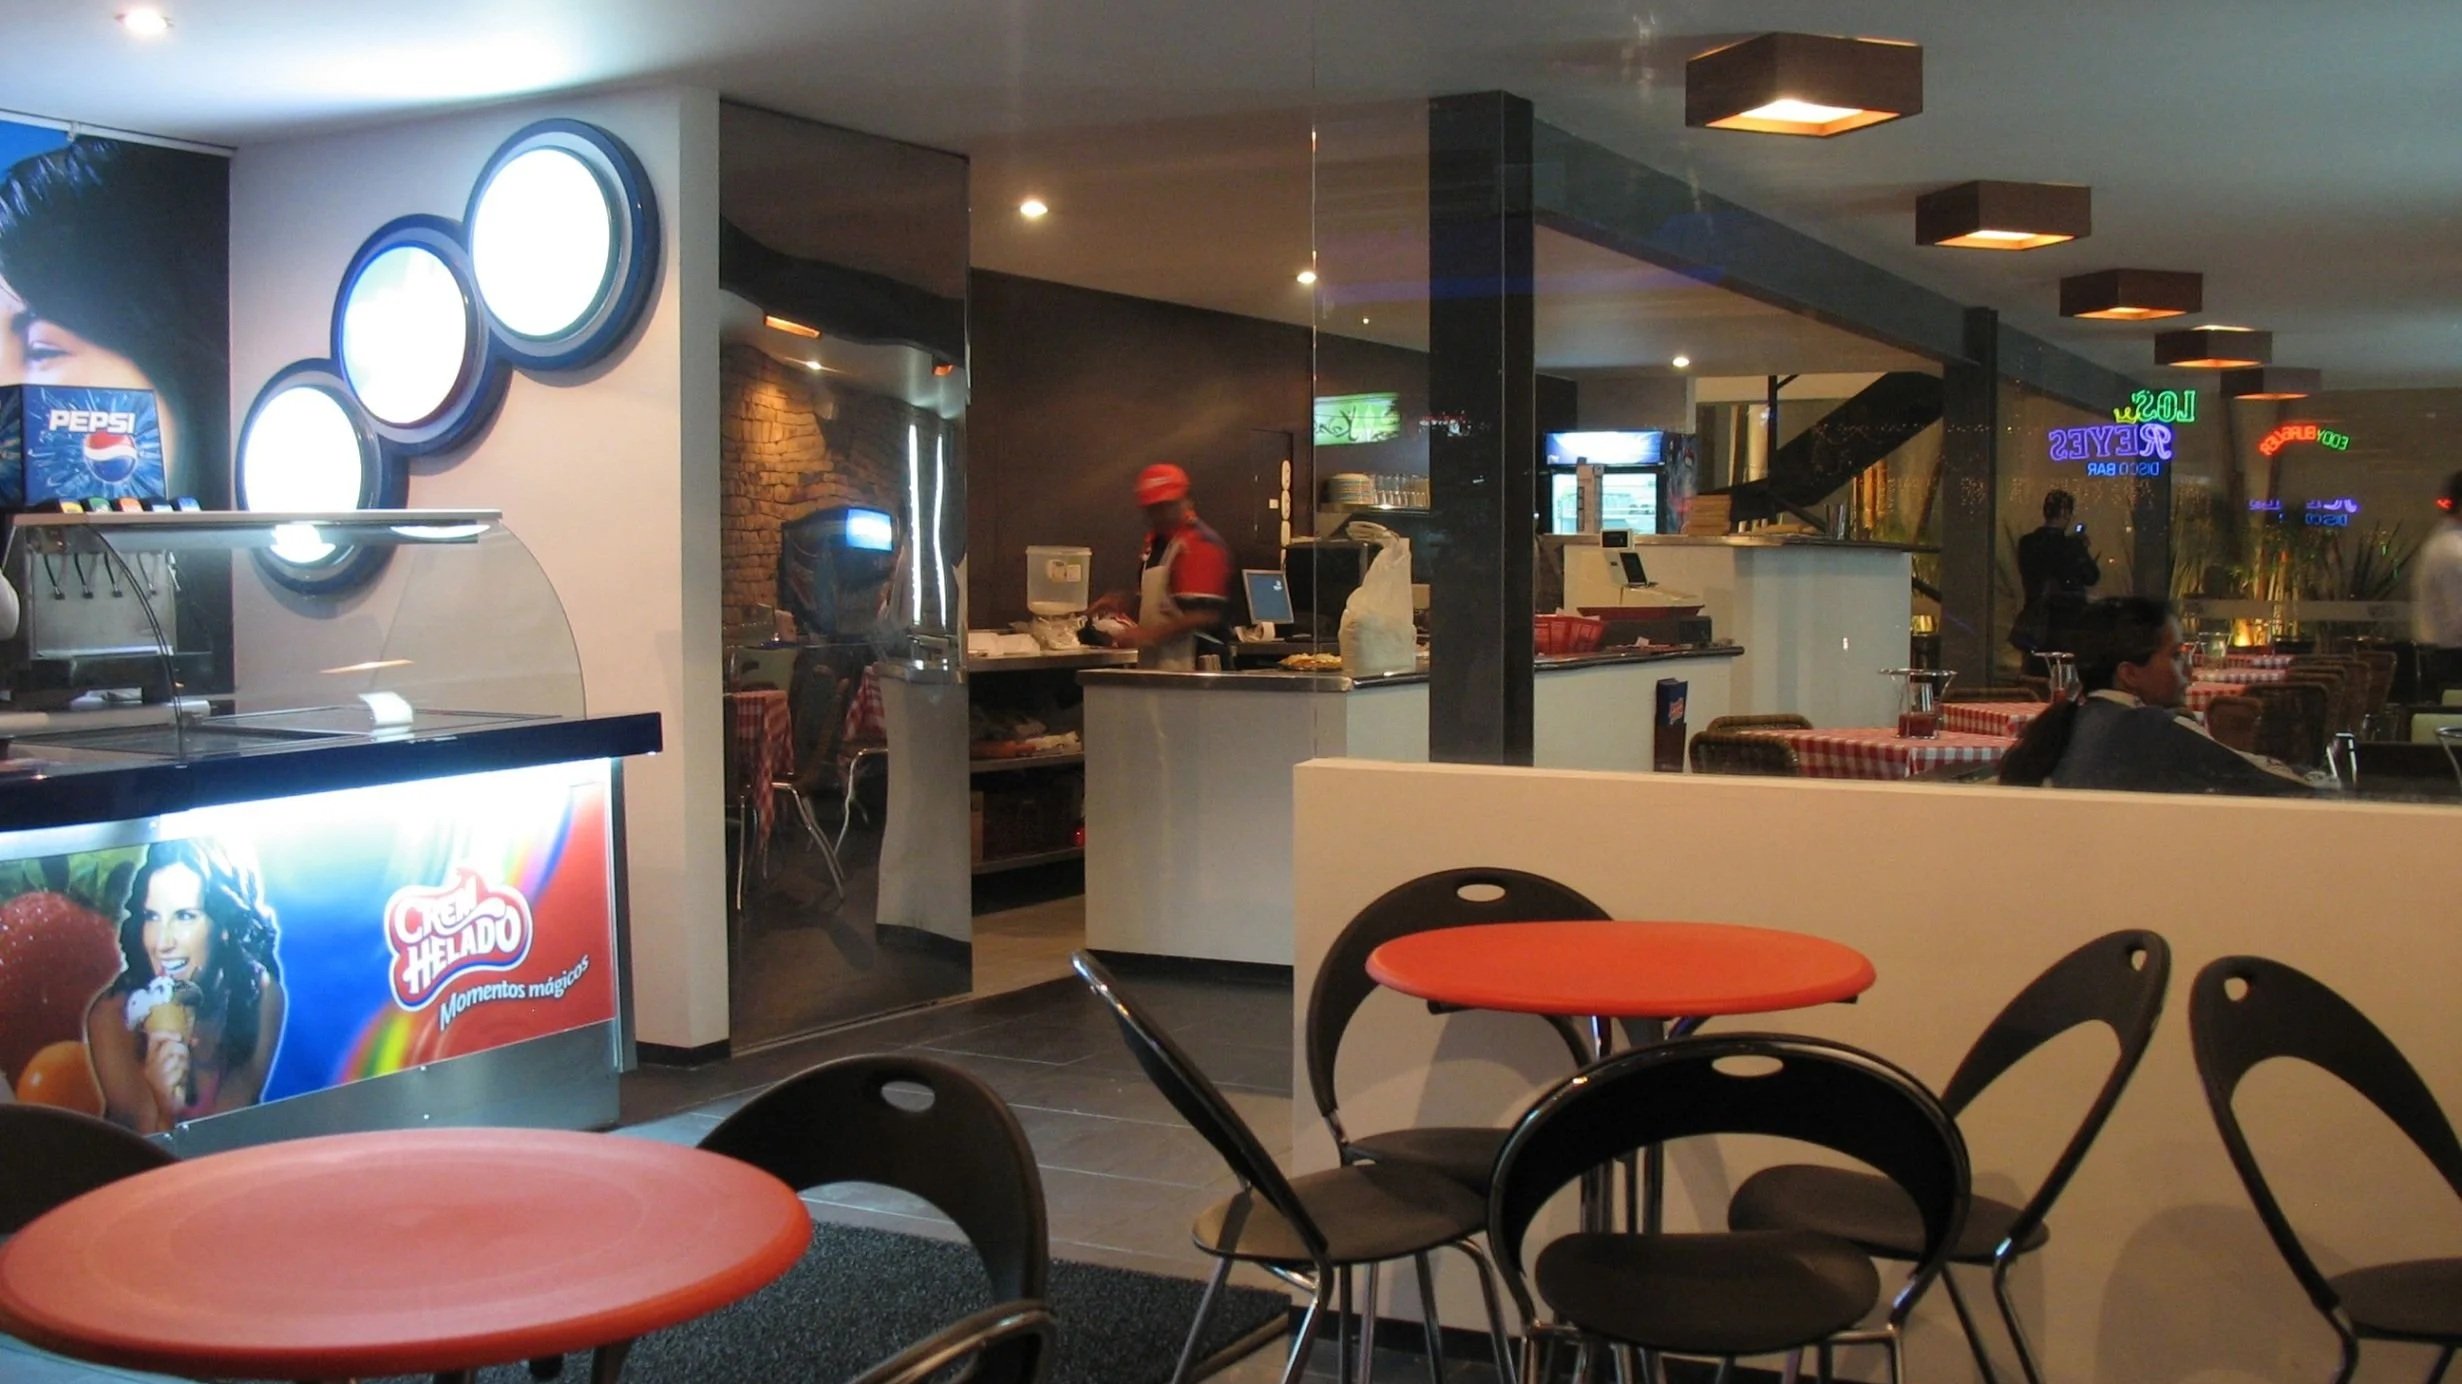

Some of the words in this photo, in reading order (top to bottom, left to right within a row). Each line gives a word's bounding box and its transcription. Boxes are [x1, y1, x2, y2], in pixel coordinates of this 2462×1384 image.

[50, 409, 136, 434] PEPSI
[394, 873, 506, 944] CREM
[402, 904, 522, 995] HELADO
[439, 980, 525, 1032] Momentos
[529, 954, 589, 999] mágicos
